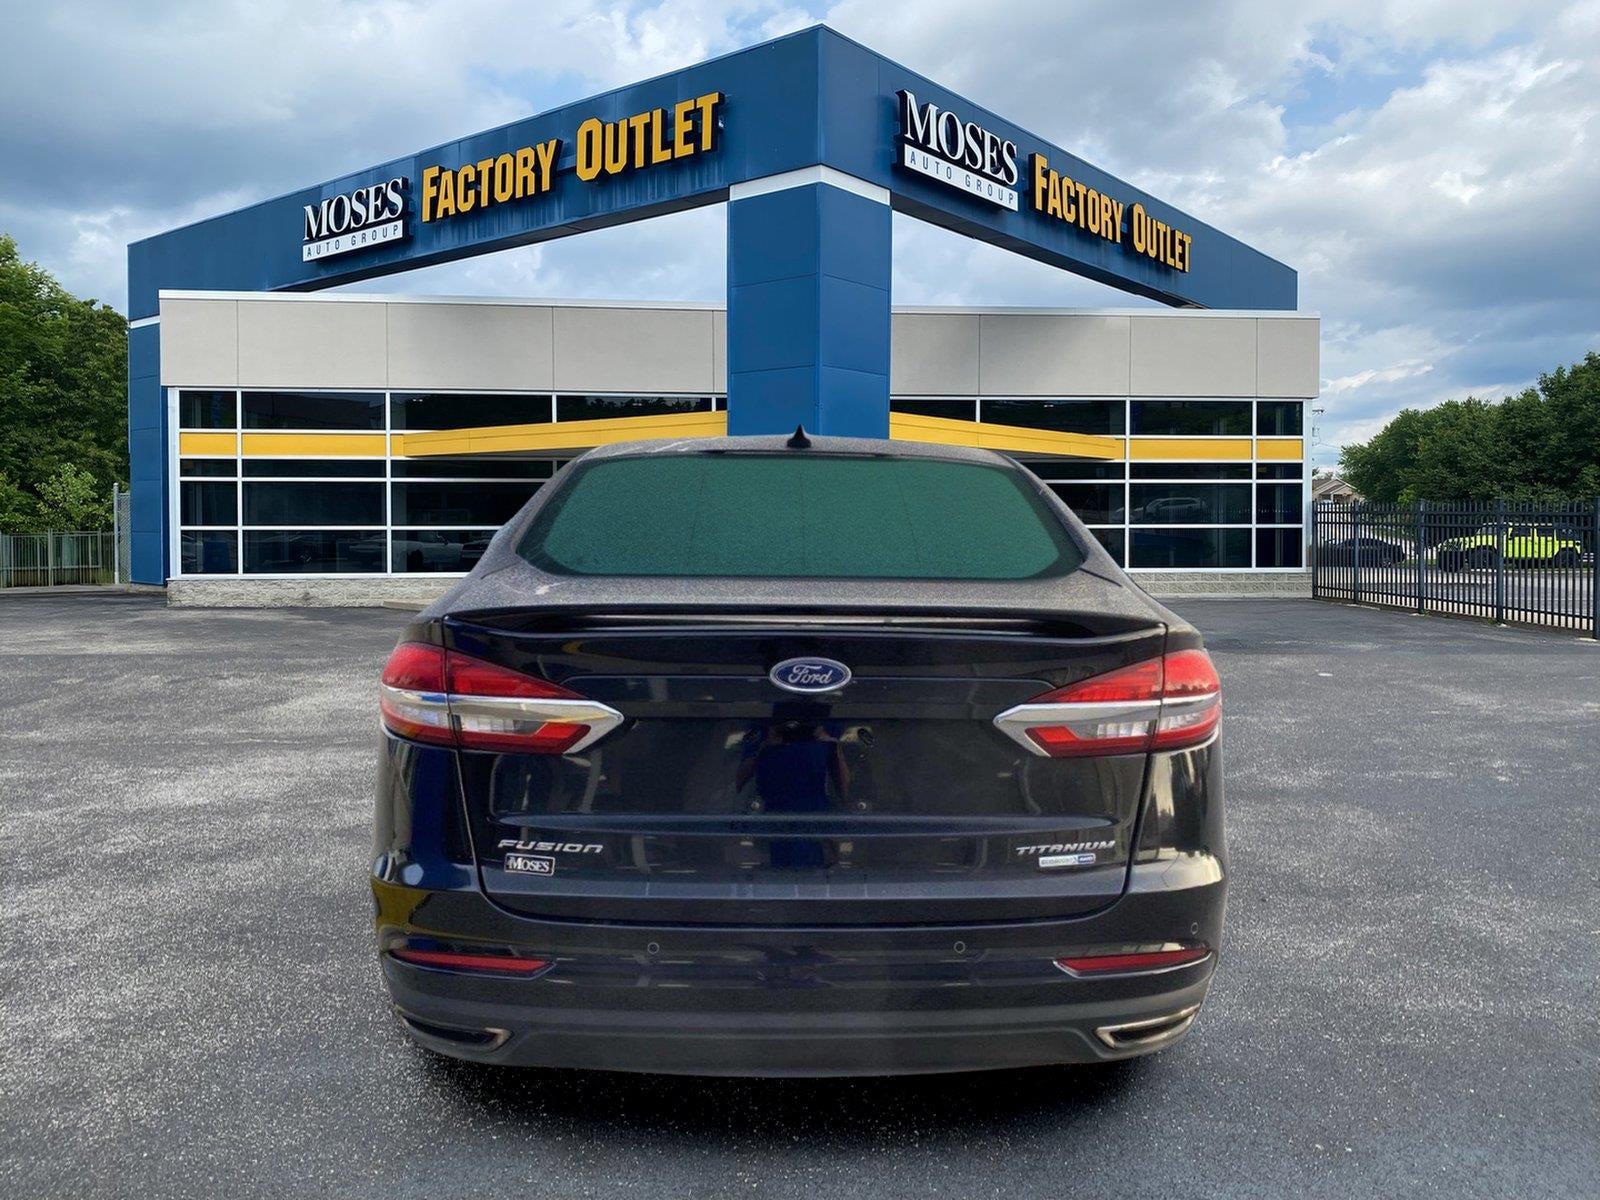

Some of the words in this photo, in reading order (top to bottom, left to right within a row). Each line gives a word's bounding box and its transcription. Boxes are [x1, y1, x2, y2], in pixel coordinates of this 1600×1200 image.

[422, 138, 558, 222] FACTORY
[576, 92, 719, 181] OUTLET
[904, 90, 1018, 186] MOSES
[910, 151, 952, 180] AUTO
[965, 174, 1014, 205] GROUP
[303, 178, 403, 240] MOSES
[1035, 153, 1124, 243] FACTORY
[1132, 203, 1192, 272] OUTLET
[307, 240, 340, 257] AUTO
[351, 225, 399, 246] GROUP
[788, 664, 833, 684] Ford
[498, 839, 603, 853] FUSION
[508, 856, 550, 873] MOSES
[1016, 840, 1116, 856] TITANIUM
